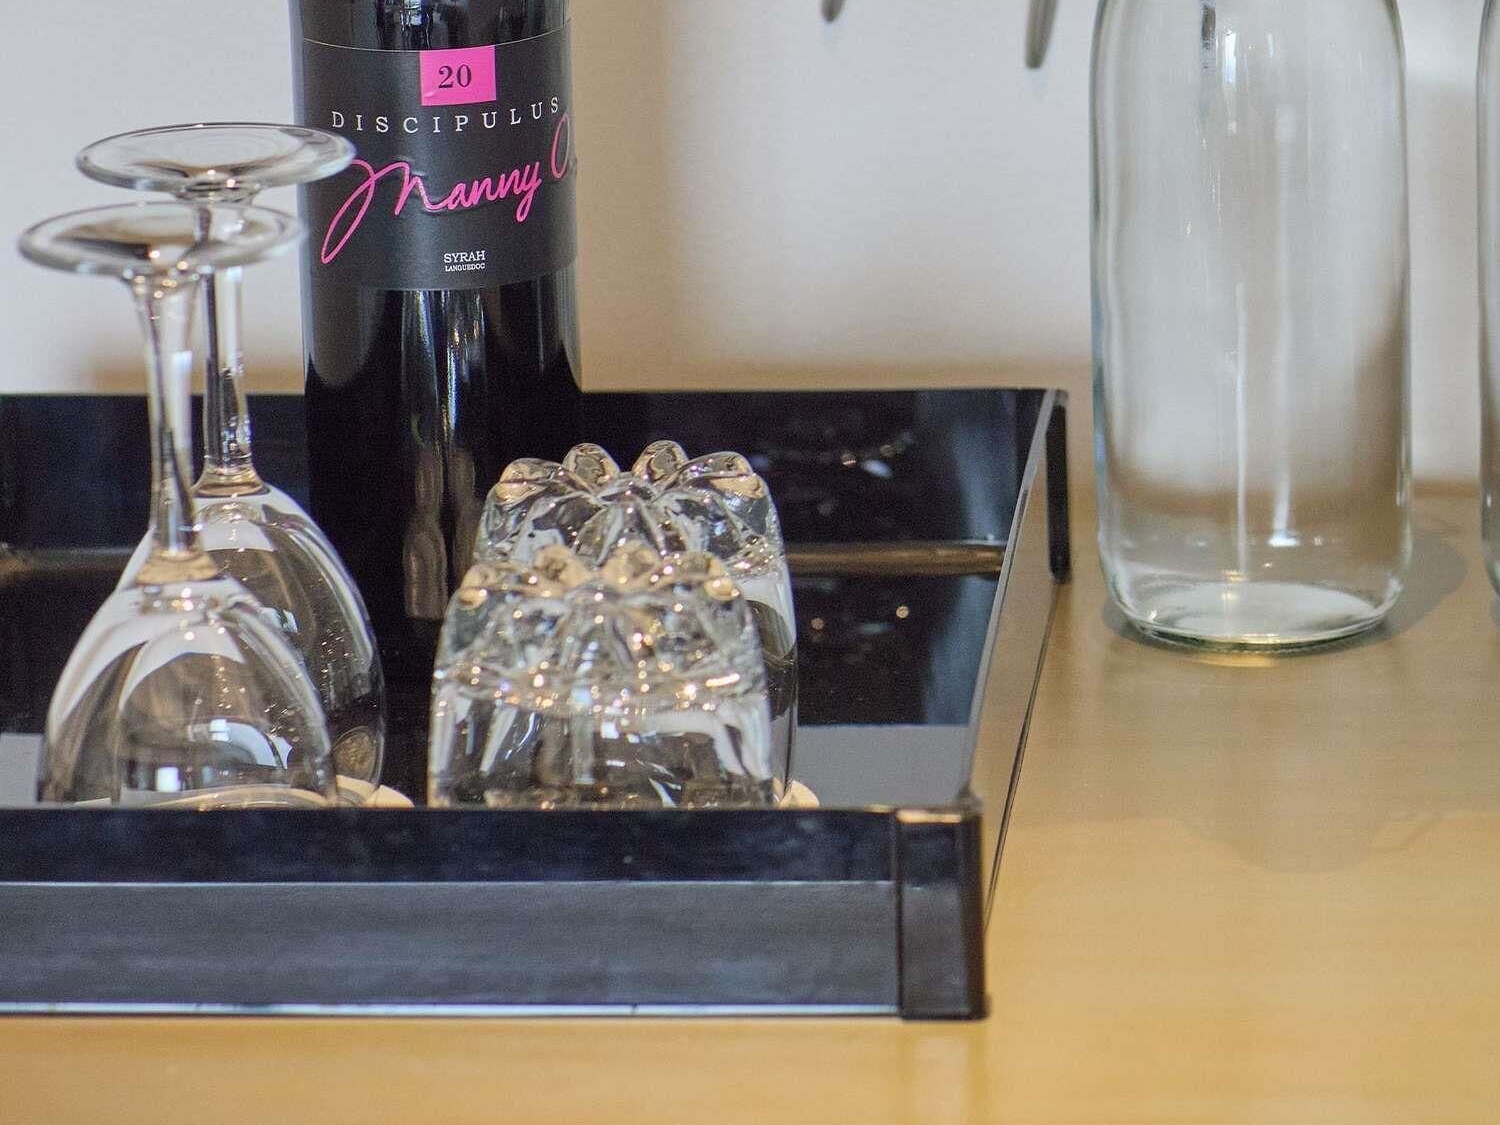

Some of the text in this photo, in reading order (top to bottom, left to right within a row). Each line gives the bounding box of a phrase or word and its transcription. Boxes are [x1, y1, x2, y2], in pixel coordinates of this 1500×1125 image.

[438, 64, 472, 88] 20
[332, 97, 558, 133] DISCIPULUS
[321, 159, 542, 264] Manny
[443, 250, 486, 263] SYRAH
[445, 263, 486, 272] LANGUEDOC
